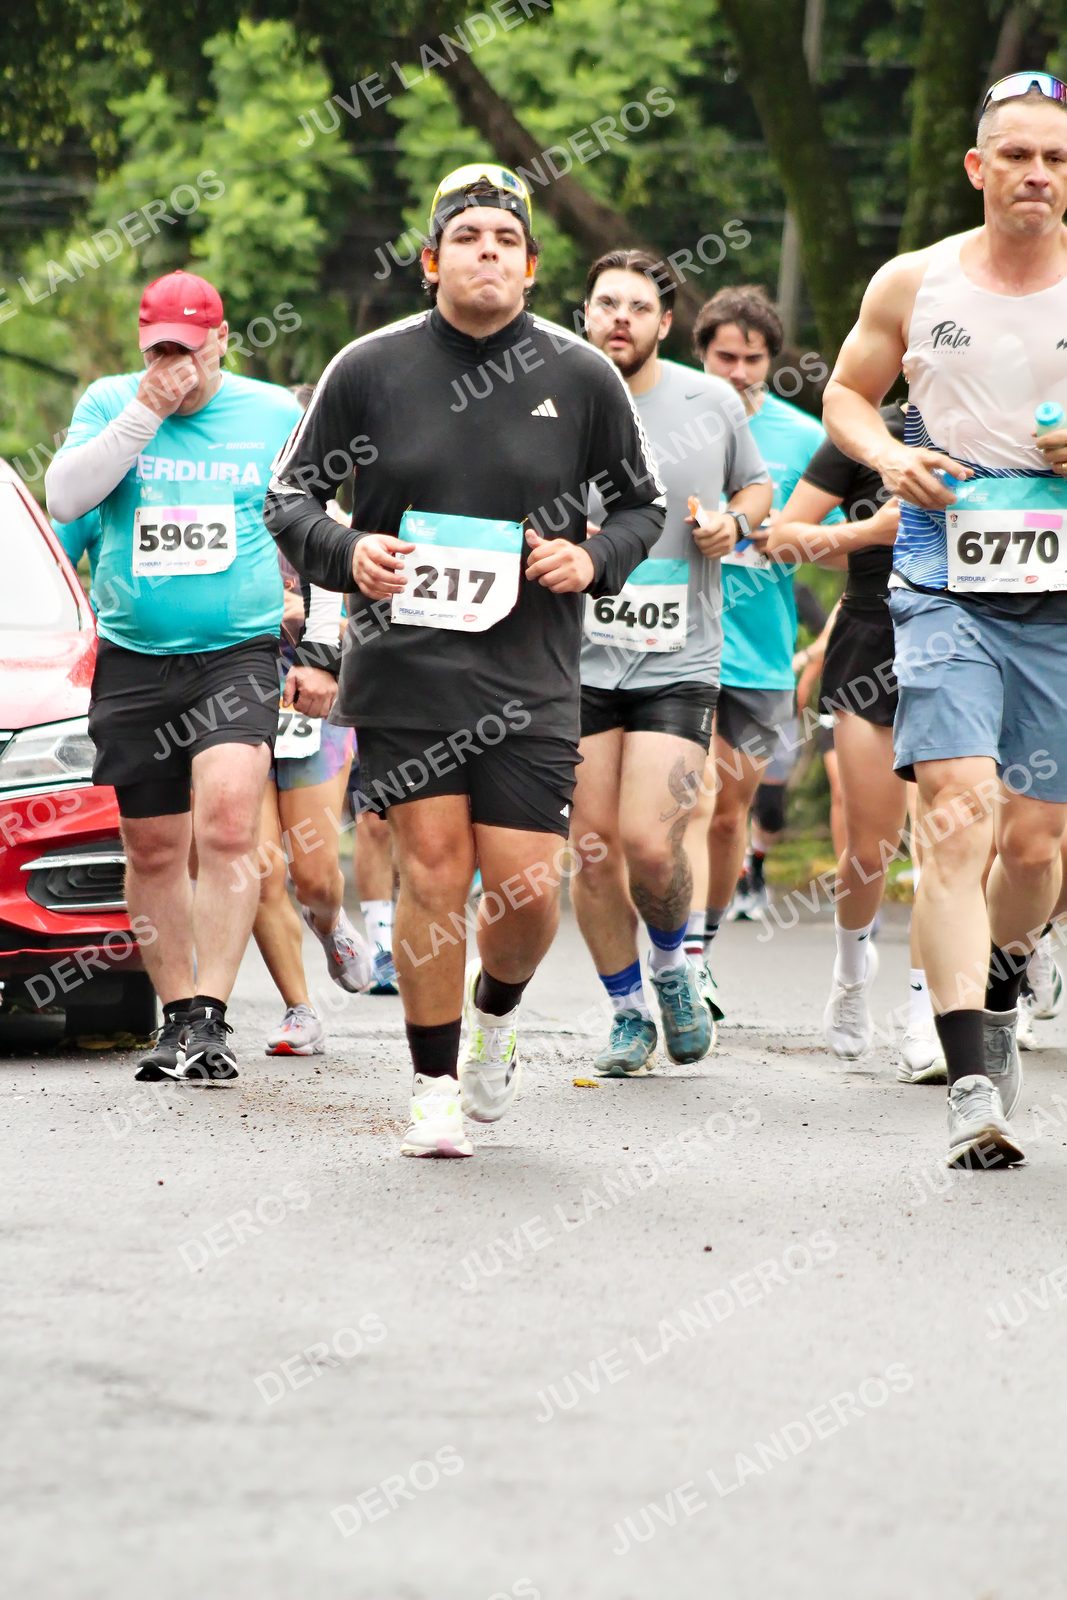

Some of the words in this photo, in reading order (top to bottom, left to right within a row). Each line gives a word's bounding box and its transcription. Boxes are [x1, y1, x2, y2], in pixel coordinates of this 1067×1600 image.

[931, 320, 971, 349] Pata
[137, 453, 262, 486] ERDURA
[139, 523, 228, 552] 5962
[957, 531, 1059, 565] 6770
[413, 565, 496, 604] 217
[593, 597, 680, 629] 6405
